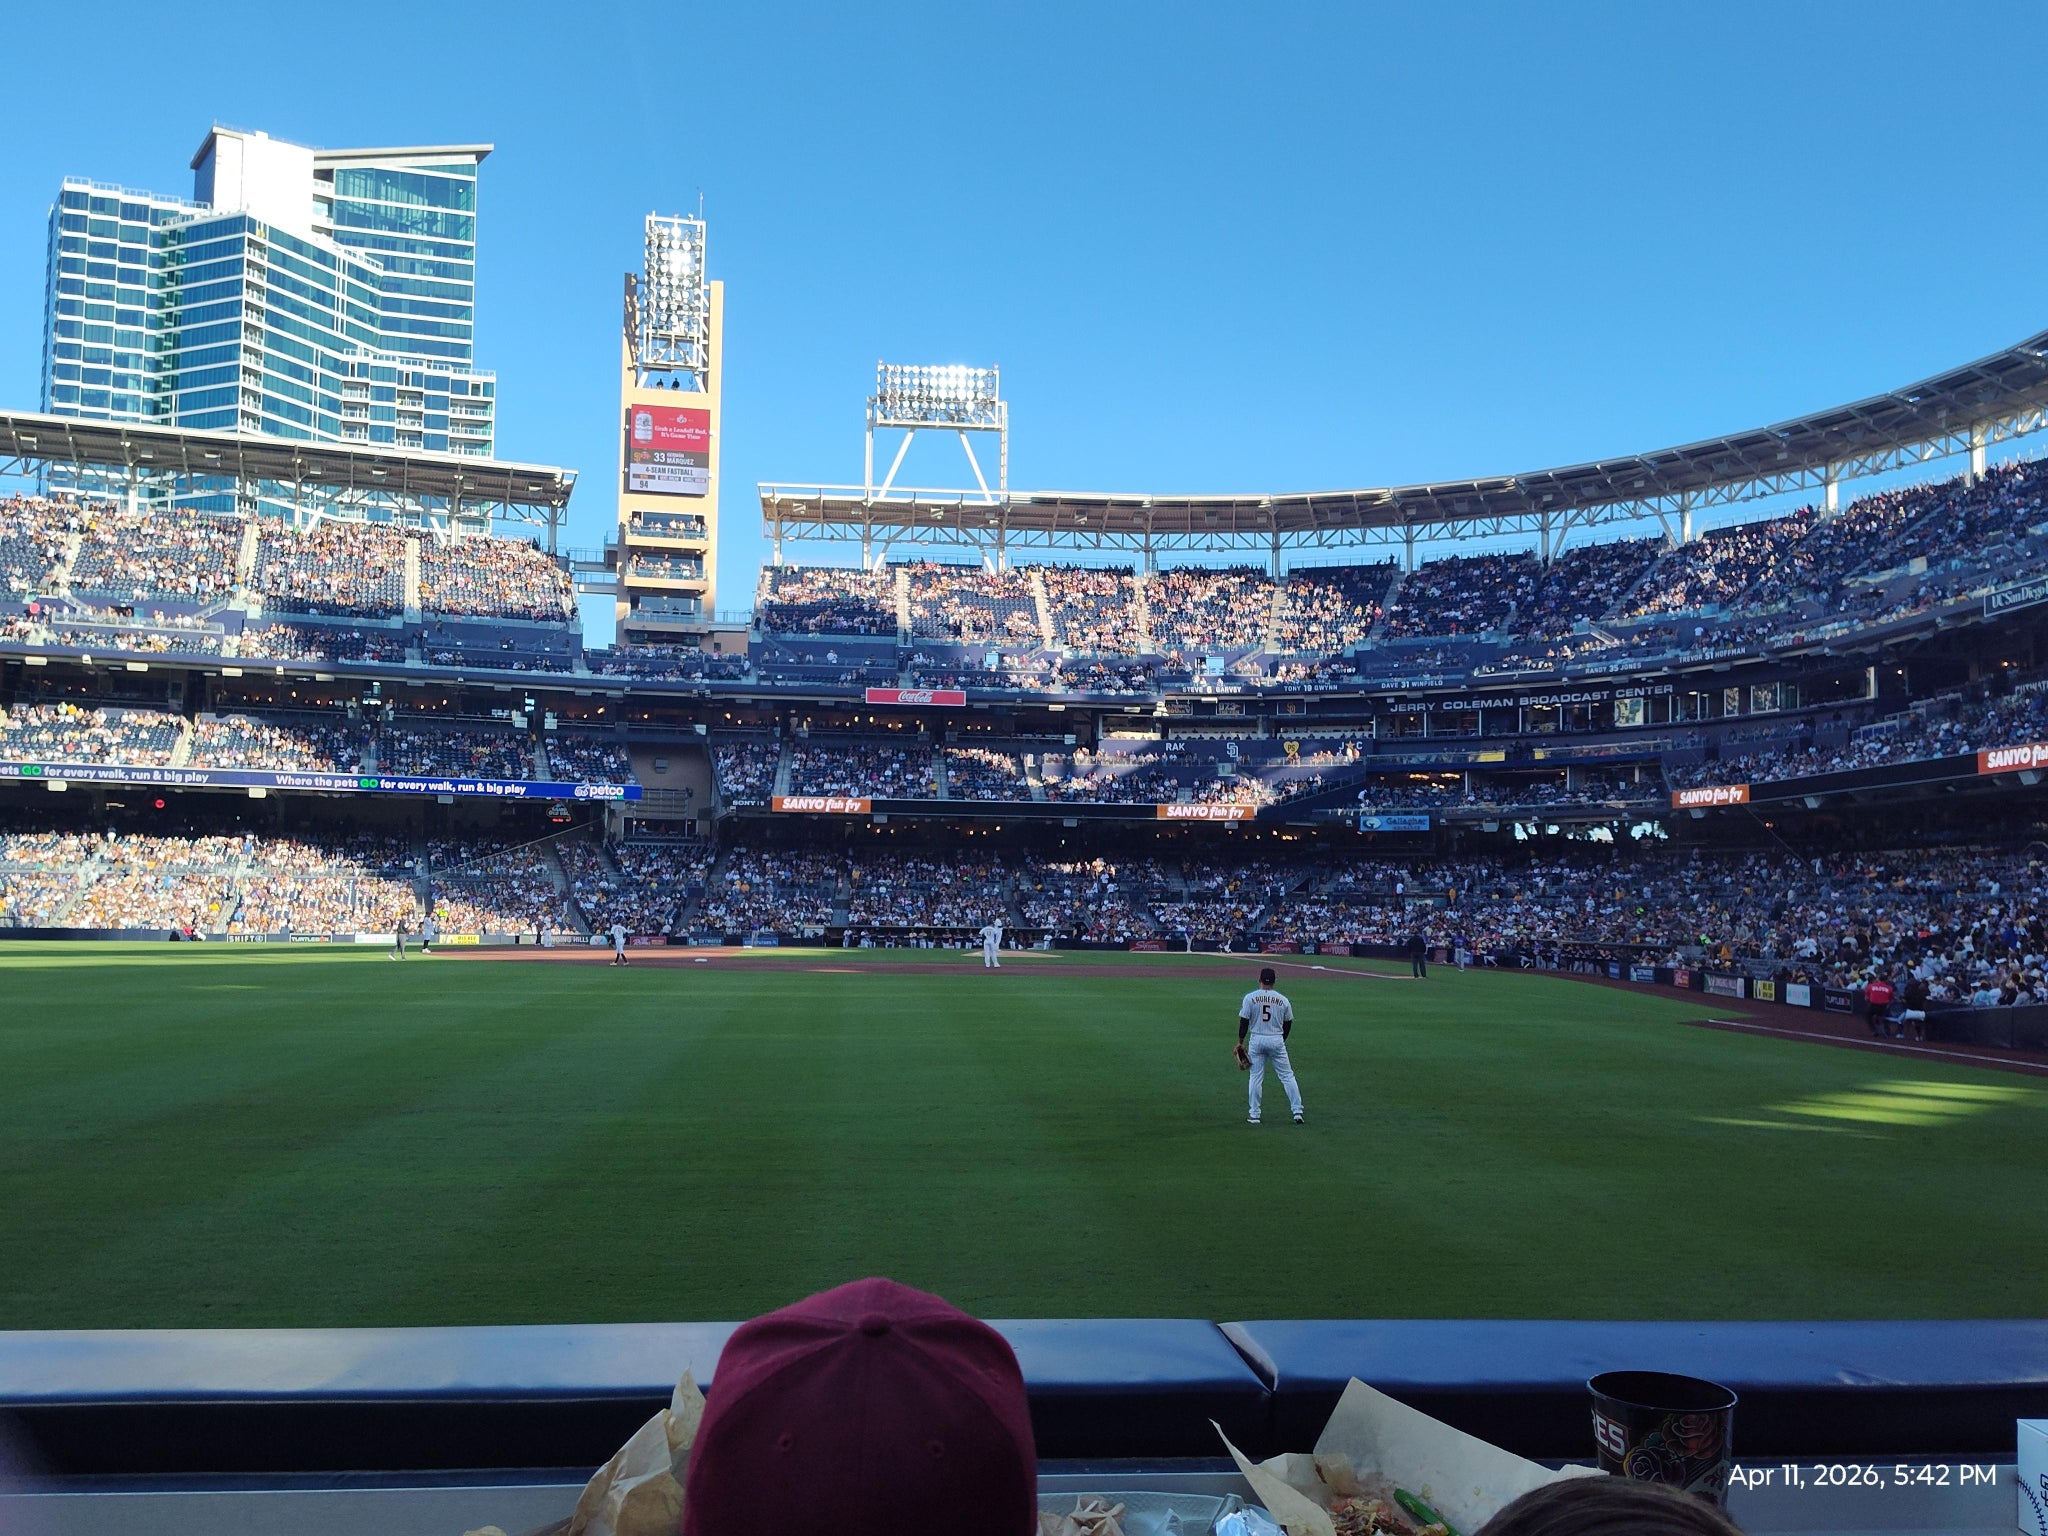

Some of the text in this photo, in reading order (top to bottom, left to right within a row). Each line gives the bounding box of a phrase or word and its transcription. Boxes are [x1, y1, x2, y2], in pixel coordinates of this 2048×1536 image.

[654, 452, 666, 463] 33
[645, 466, 694, 476] 4-SEAM FASTBALL
[639, 480, 649, 489] 94
[1679, 654, 1703, 664] TREVOR
[1714, 648, 1746, 659] HOFFMAN
[1585, 662, 1642, 675] RANDY 35 JONES
[1401, 681, 1410, 689] 31
[898, 691, 934, 702] Coca-Cola
[1390, 684, 1673, 713] JERRY COLEMAN BROADCAST CENTER
[1165, 742, 1186, 752] RAK
[1987, 746, 2031, 769] SANYO
[0, 765, 210, 785] ets GO for every walk, run & big play
[275, 774, 527, 796] Where the pets GO for every walk, run & big play
[589, 785, 625, 798] petco
[1679, 786, 1743, 805] SANYO fish fry
[782, 798, 861, 813] SANYO fish fry
[1166, 806, 1245, 819] SANYO fish fry
[1262, 1004, 1271, 1022] 5
